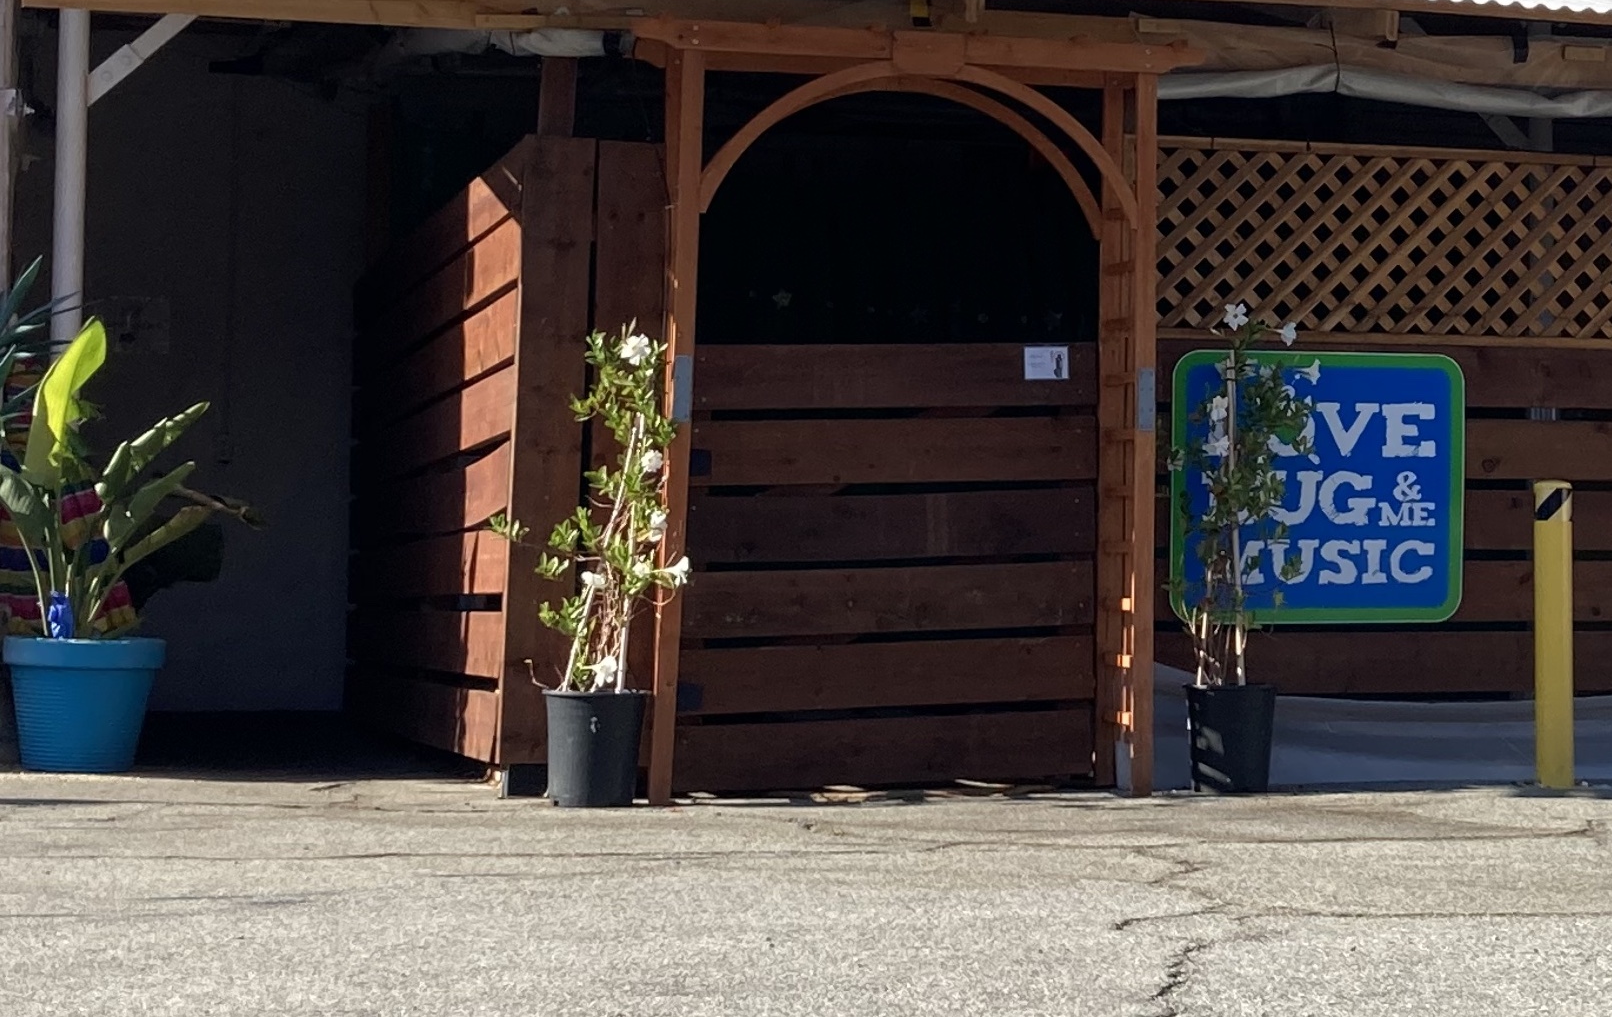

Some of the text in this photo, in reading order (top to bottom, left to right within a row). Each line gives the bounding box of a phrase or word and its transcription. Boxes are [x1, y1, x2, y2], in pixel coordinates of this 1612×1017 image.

[1203, 401, 1436, 458] OVE
[1202, 470, 1376, 526] UG
[1392, 470, 1422, 502] &
[1378, 502, 1436, 526] ME
